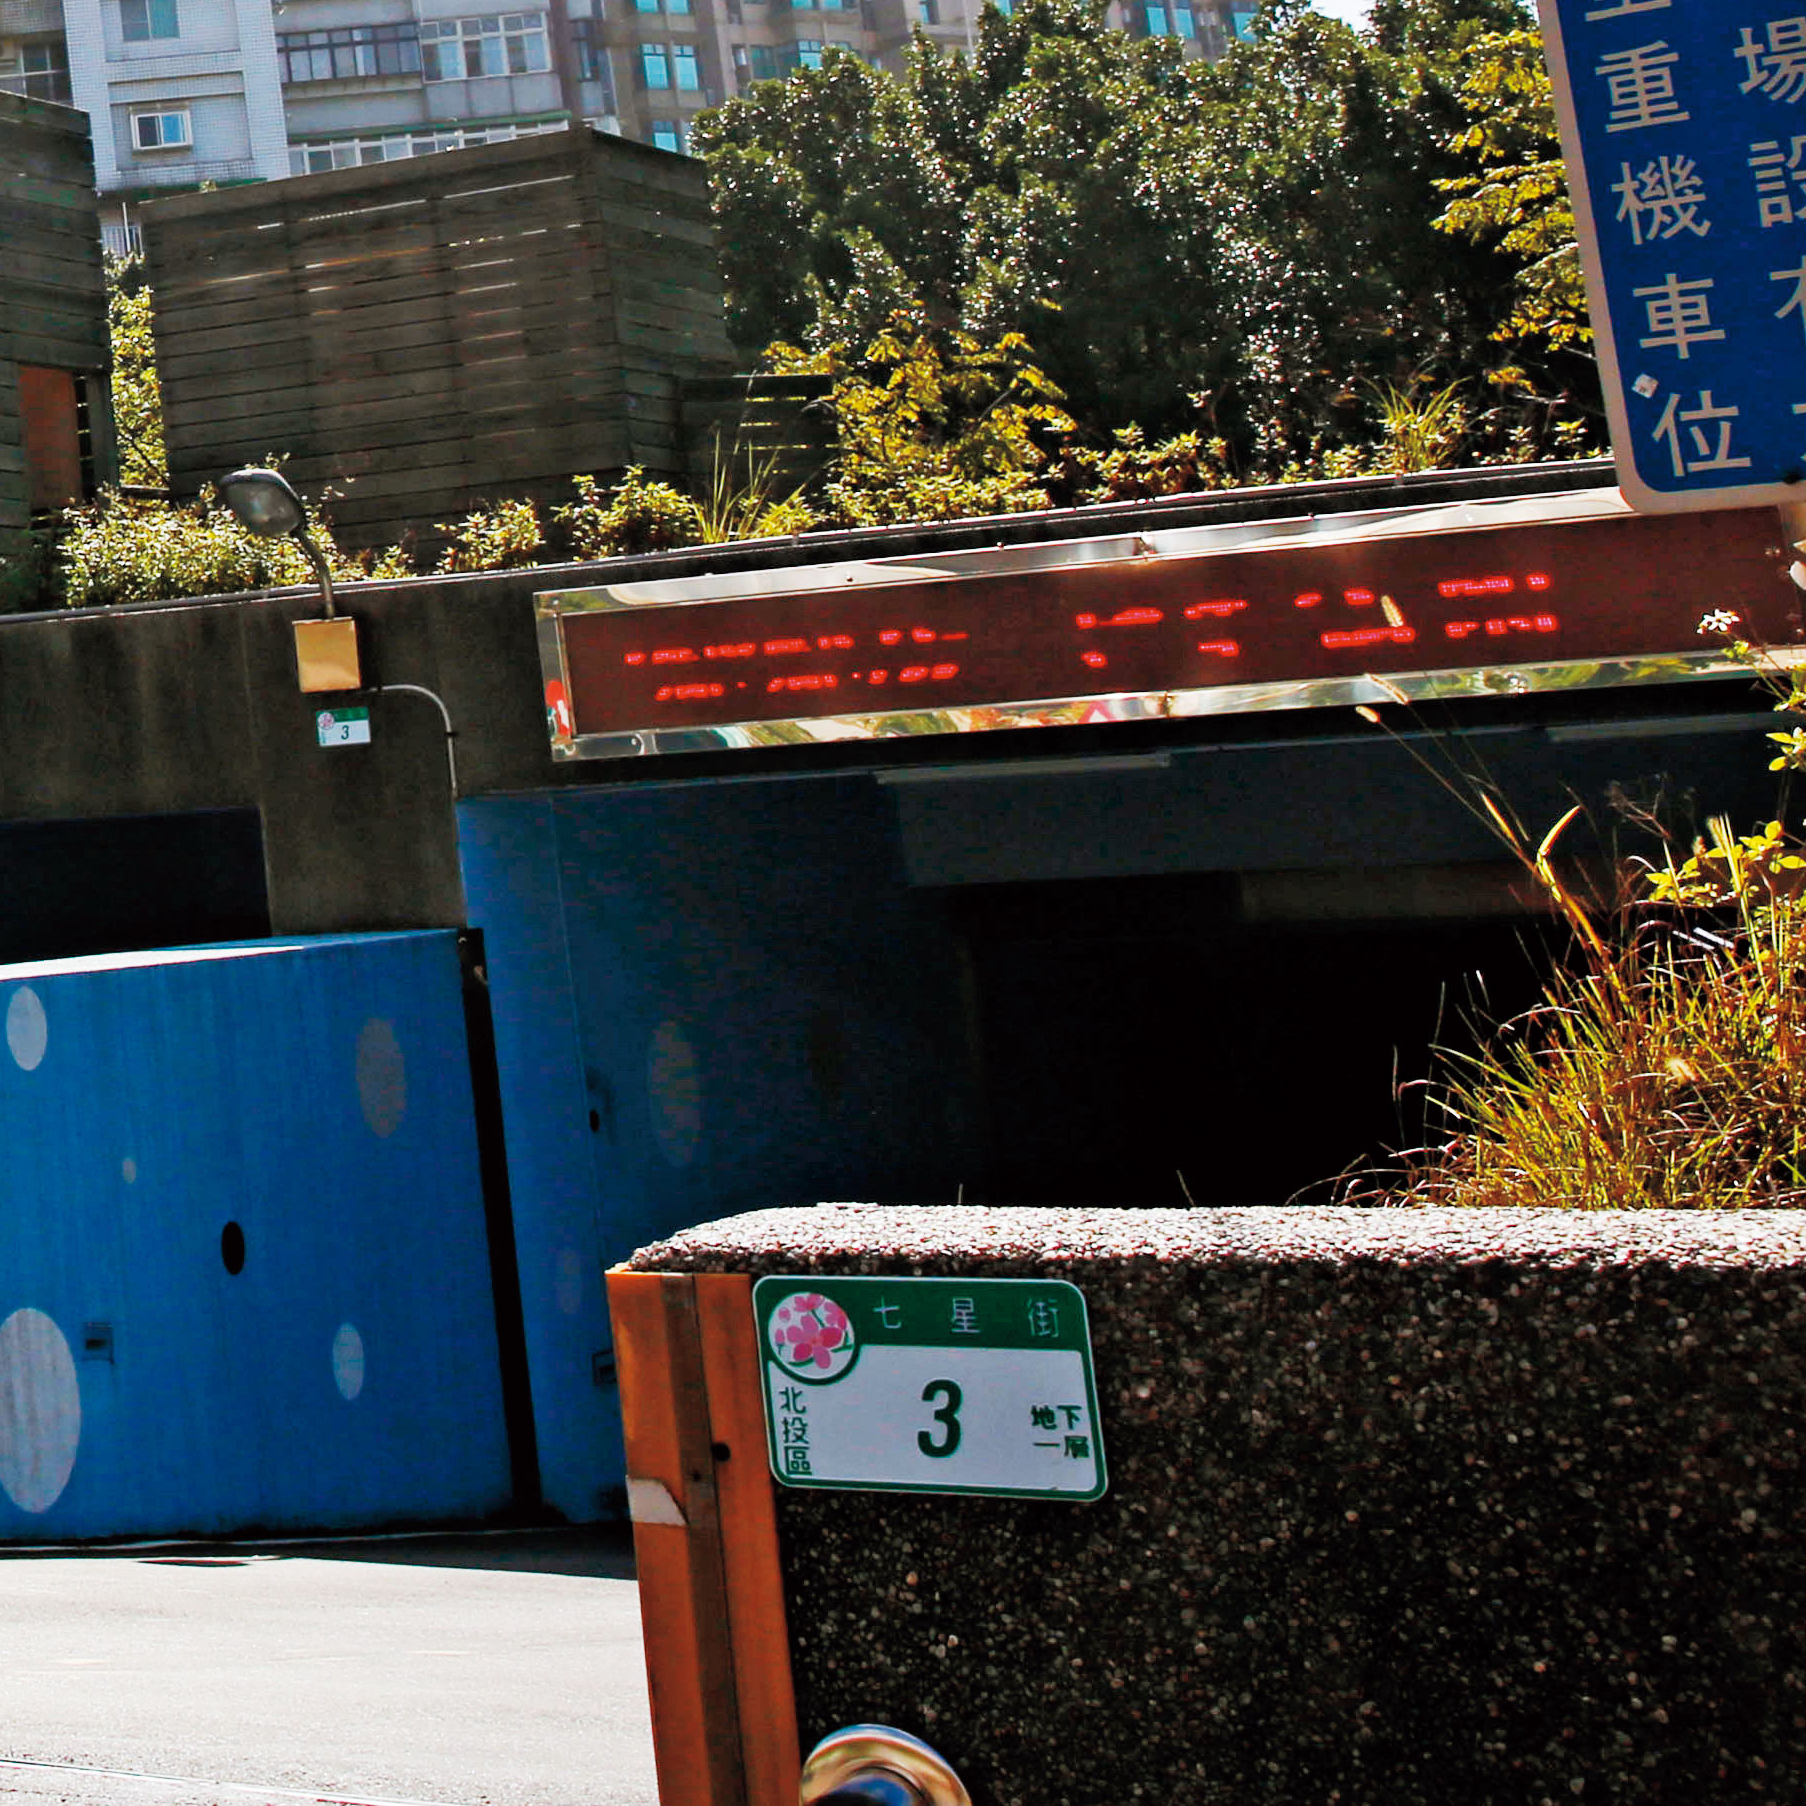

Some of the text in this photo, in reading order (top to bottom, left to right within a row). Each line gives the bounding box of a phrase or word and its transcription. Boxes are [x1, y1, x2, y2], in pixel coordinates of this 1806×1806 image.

[341, 725, 349, 740] 3
[873, 1296, 1059, 1338] 七星街
[779, 1387, 812, 1475] 北投區
[917, 1379, 963, 1458] 3
[1031, 1404, 1082, 1430] 地下
